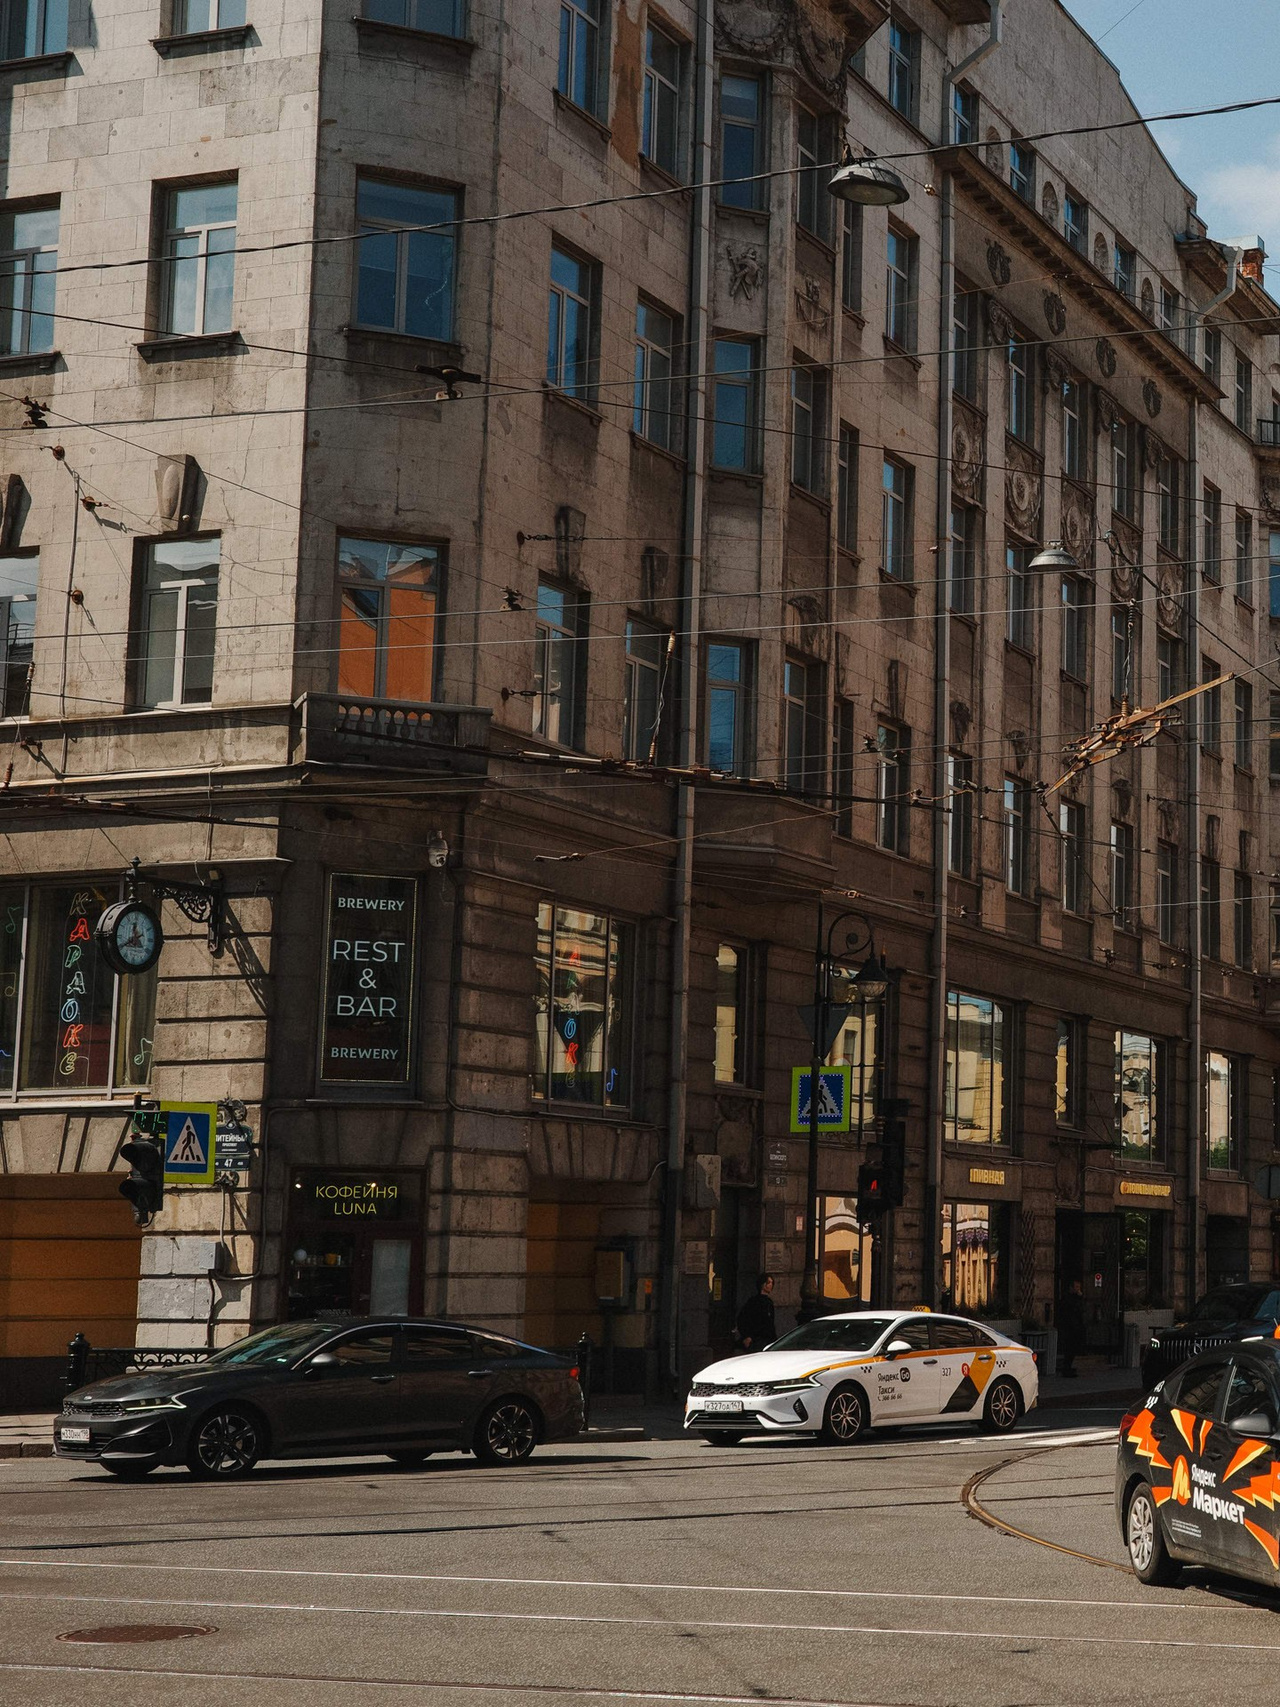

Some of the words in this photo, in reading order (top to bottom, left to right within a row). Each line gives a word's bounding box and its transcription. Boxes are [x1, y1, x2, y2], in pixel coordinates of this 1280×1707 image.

[338, 897, 405, 911] BREWERY
[333, 940, 406, 963] REST
[59, 892, 91, 1075] КАРАОКЕ
[358, 968, 377, 989] &
[336, 995, 397, 1018] BAR
[331, 1047, 399, 1061] BREWERY
[224, 1158, 233, 1168] 47
[316, 1183, 398, 1199] КОФЕЙНЯ
[334, 1202, 377, 1215] LUNA
[878, 1372, 899, 1382] Яндекс
[901, 1370, 909, 1380] Go
[942, 1368, 951, 1376] 327
[878, 1386, 895, 1395] Такси
[1192, 1463, 1217, 1488] Яндекс
[1193, 1488, 1245, 1525] Маркет
